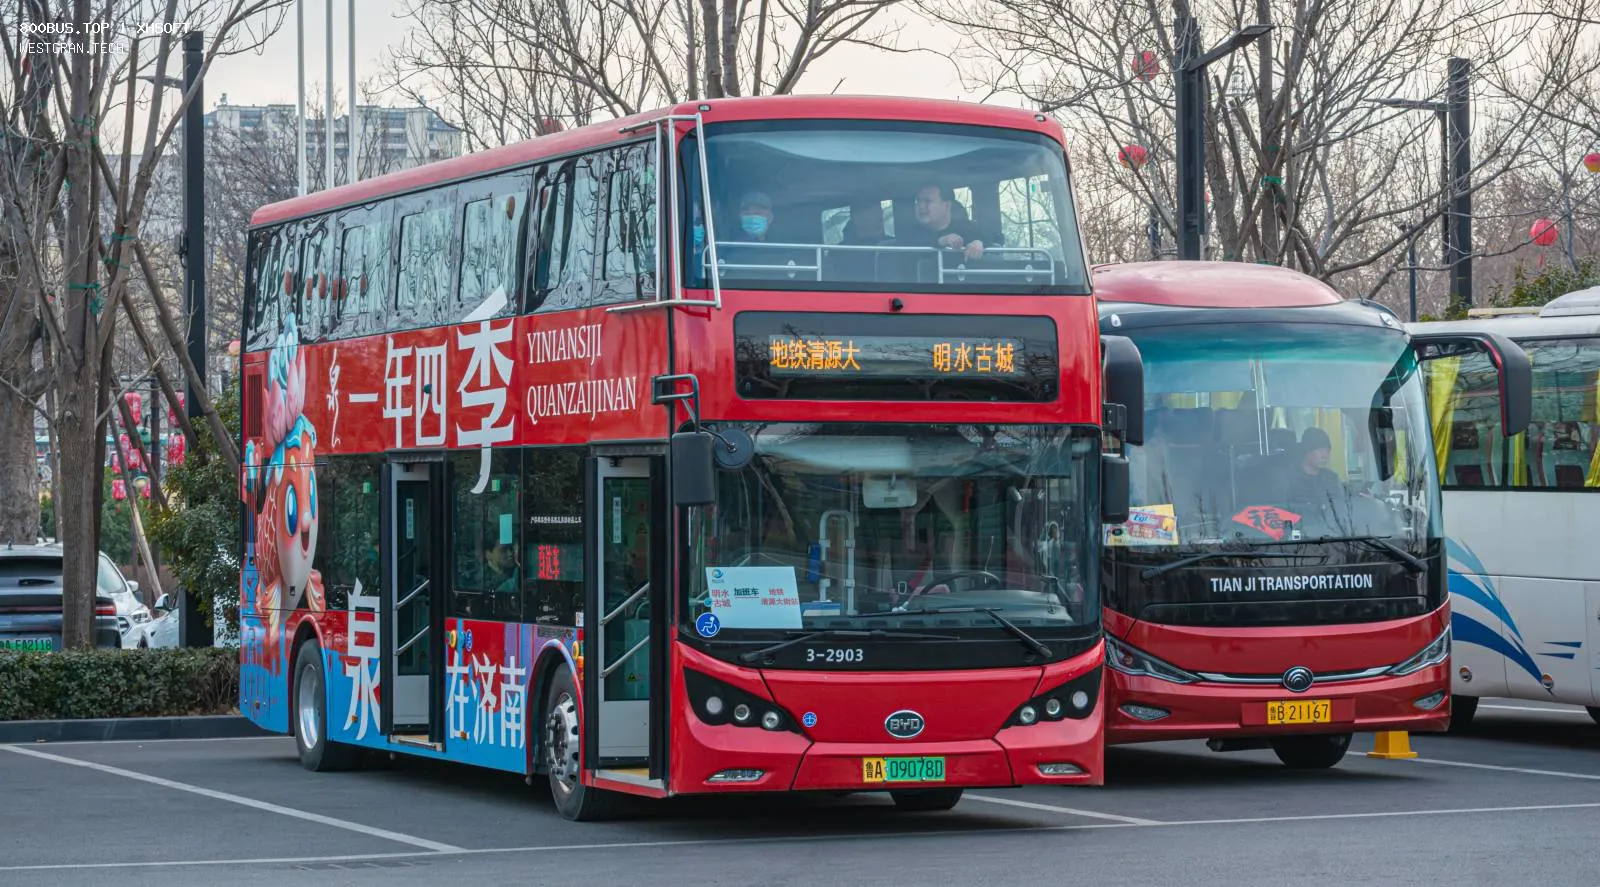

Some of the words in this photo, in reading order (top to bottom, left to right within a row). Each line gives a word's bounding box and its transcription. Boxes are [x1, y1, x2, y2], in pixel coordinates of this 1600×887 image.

[526, 323, 603, 368] YINIANSIJI
[769, 339, 861, 372] 地铁清源大
[933, 341, 1014, 373] 明水古城
[348, 284, 516, 495] 一年四季
[526, 376, 637, 425] QUANZAIJINAN
[1210, 576, 1243, 593] TIAN
[1244, 576, 1256, 592] JI
[1258, 574, 1373, 592] TRANSPORTATION
[806, 648, 864, 663] 3-2903
[889, 718, 920, 731] BYD
